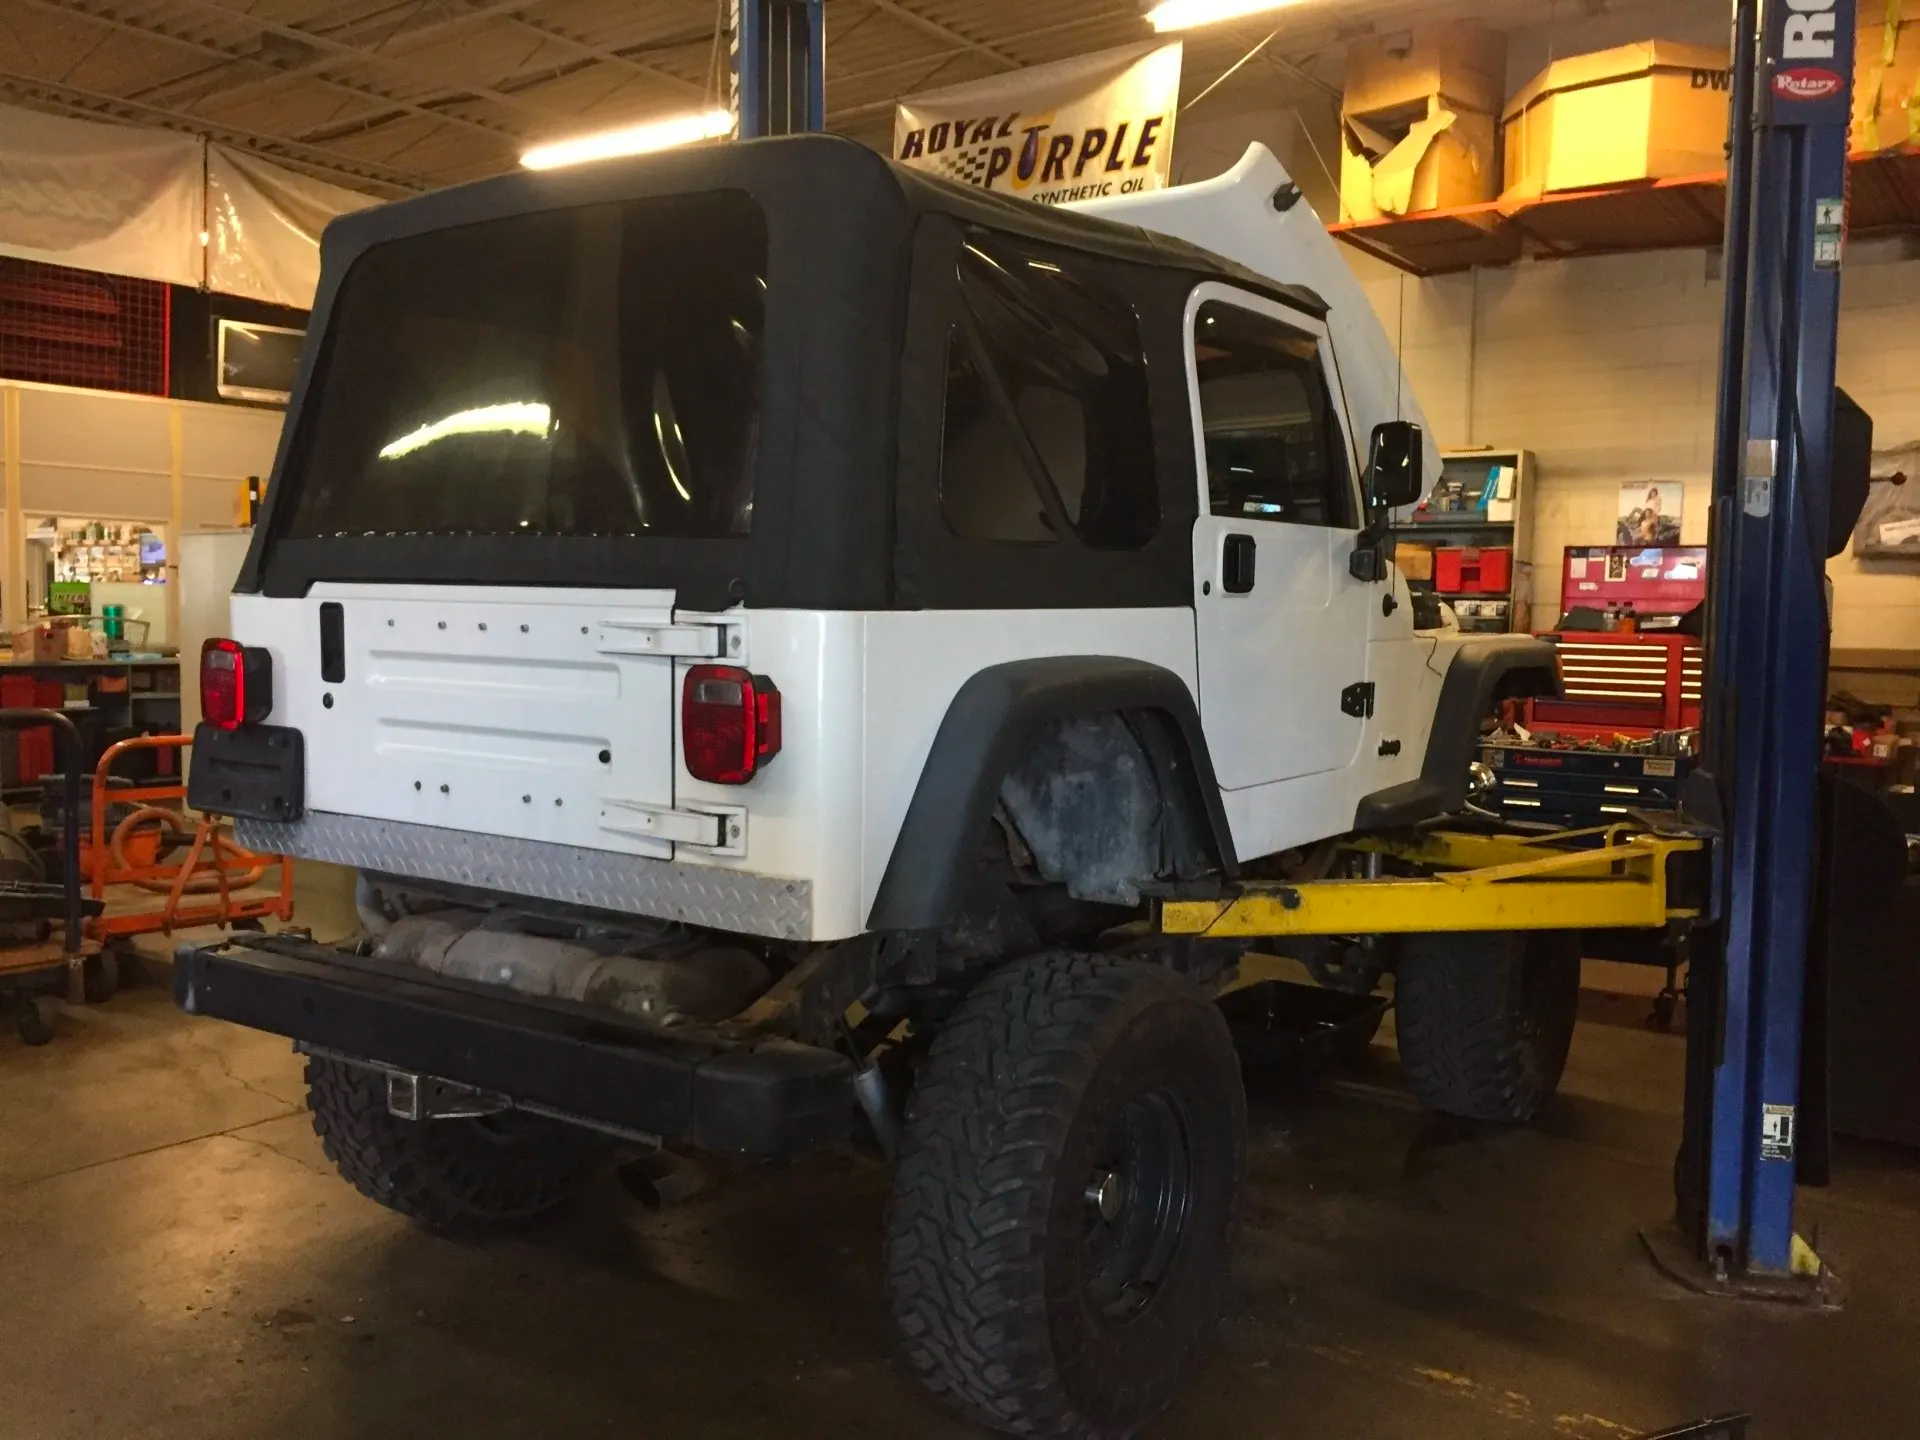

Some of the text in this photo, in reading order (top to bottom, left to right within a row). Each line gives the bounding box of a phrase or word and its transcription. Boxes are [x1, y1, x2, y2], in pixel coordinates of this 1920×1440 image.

[1783, 0, 1836, 58] R
[1777, 74, 1837, 94] Rotary
[899, 111, 1021, 161] ROYAL
[984, 116, 1163, 188] PURPLE
[1032, 177, 1144, 204] SYNTHETIC OIL
